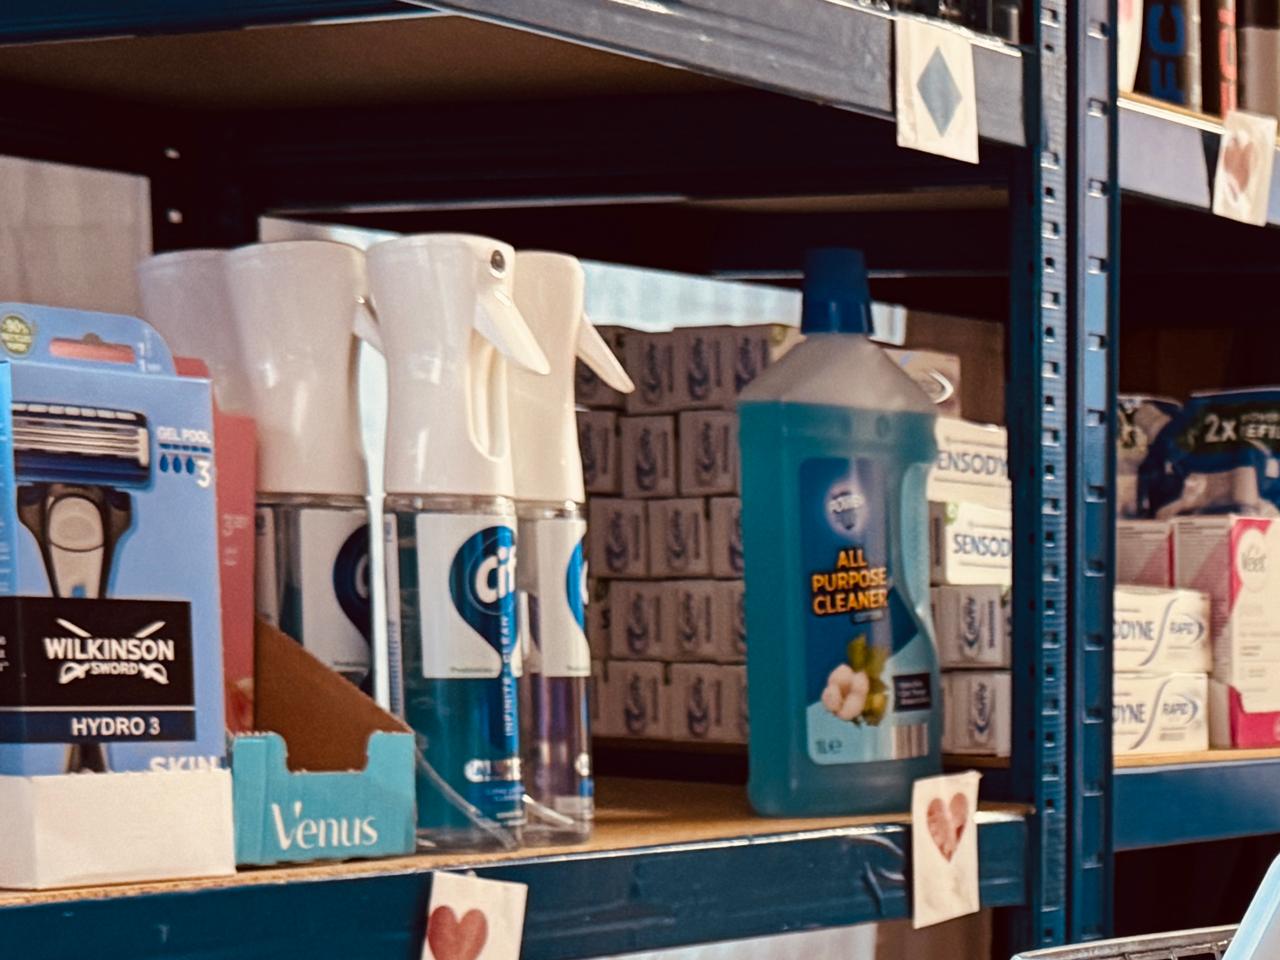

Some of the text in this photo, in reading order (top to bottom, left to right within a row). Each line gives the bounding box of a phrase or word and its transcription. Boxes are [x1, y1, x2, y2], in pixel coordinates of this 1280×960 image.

[157, 426, 211, 444] GEL POOL
[195, 460, 211, 487] 3
[838, 549, 867, 568] ALL
[812, 567, 887, 592] PURPOSE
[813, 589, 888, 615] CLEANER
[43, 637, 175, 661] WILKINSON
[90, 662, 139, 675] SWORD
[71, 717, 161, 736] HYDRO 3
[271, 800, 379, 851] Venus
